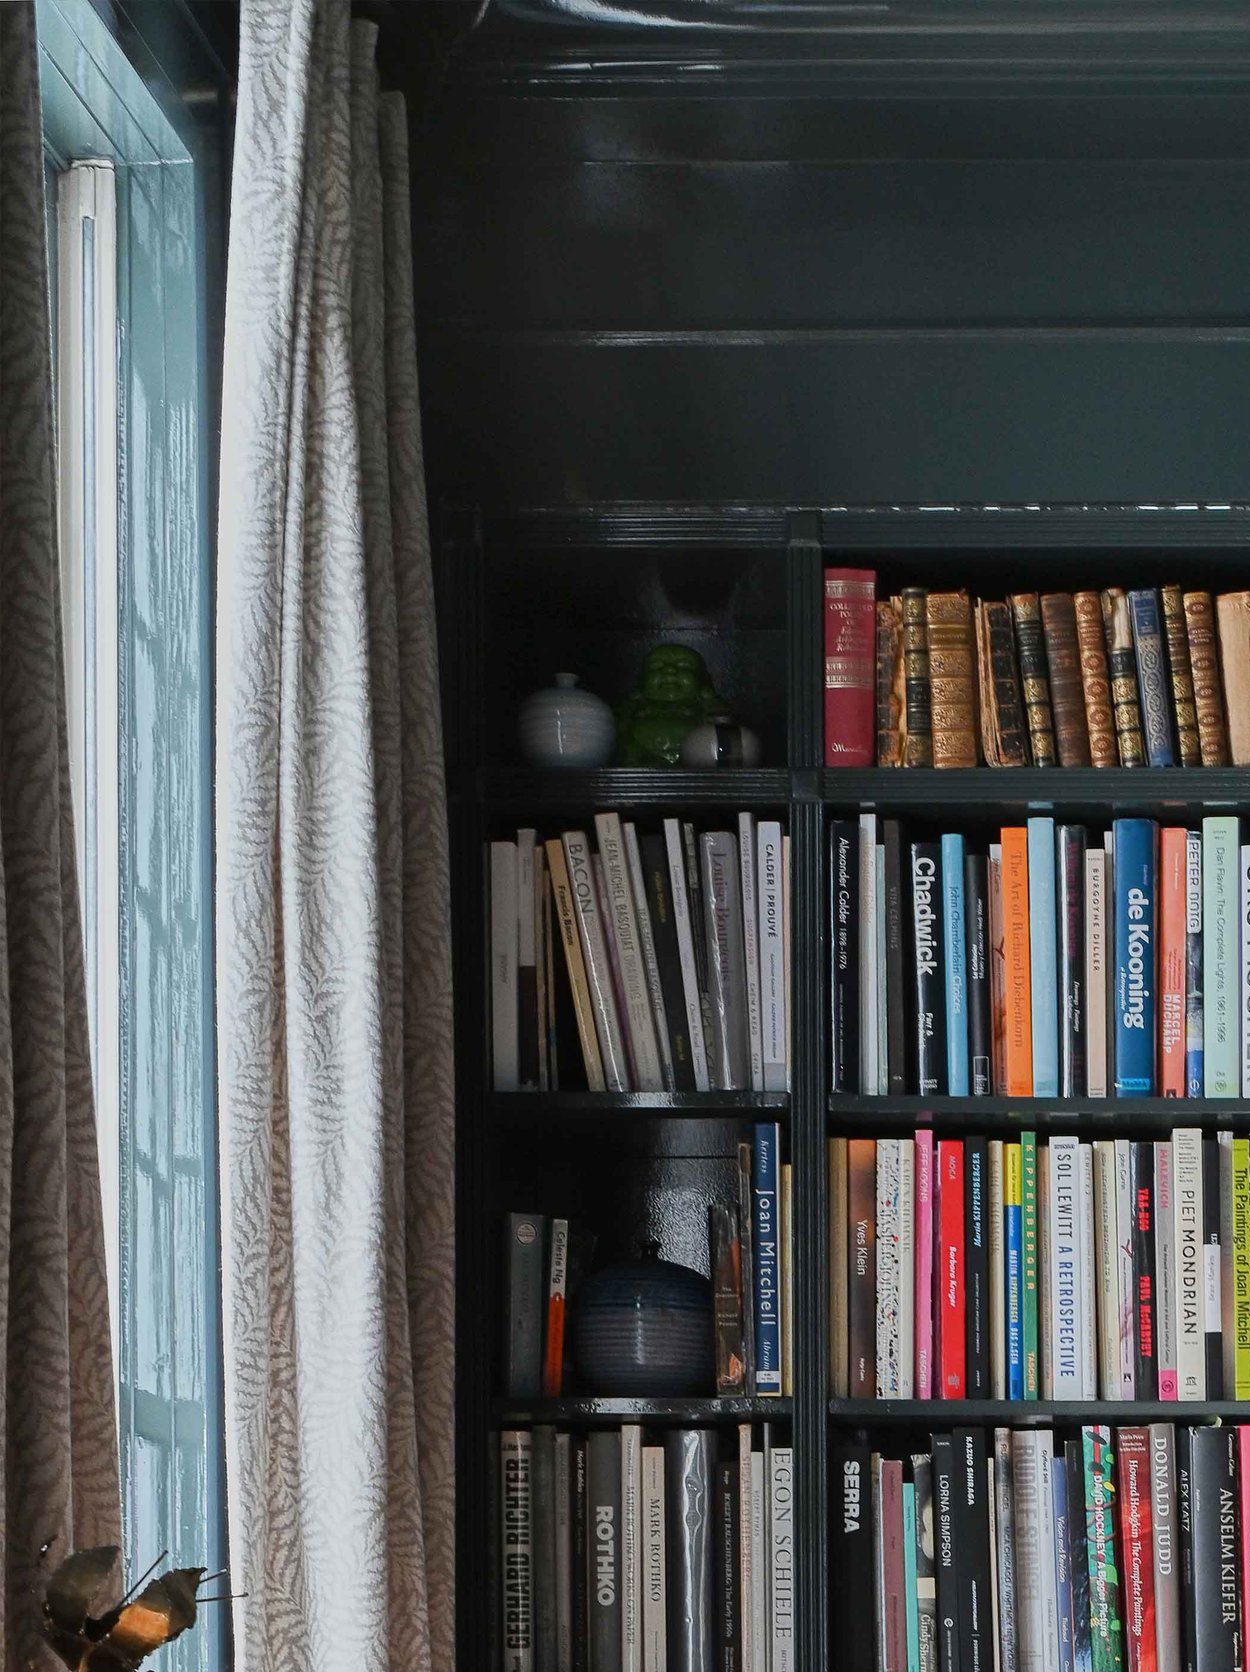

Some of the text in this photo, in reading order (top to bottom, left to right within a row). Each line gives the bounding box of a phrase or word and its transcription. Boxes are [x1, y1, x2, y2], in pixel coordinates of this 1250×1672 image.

[569, 843, 595, 914] BACON
[766, 843, 781, 938] CALDER PROUVÉ
[914, 857, 938, 978] Chadwick
[1123, 888, 1150, 1030] de Kooning
[1162, 992, 1181, 1054] MARCEL DUCHAMP
[552, 1232, 566, 1284] Celeste Ng
[754, 1187, 777, 1326] Joan Mitchell
[856, 1218, 869, 1275] Yves Klein
[1056, 1153, 1076, 1378] SOL LEWITT A RETROSPECTIVE
[1181, 1190, 1198, 1335] PIET MONDRIAN
[649, 1497, 661, 1602] MARK ROTHKO
[773, 1450, 792, 1639] EGON SCHIELE
[843, 1459, 861, 1534] SERRA
[939, 1474, 952, 1567] LORNA SIMPSON
[1153, 1435, 1172, 1576] DONALD JUDD
[506, 1458, 531, 1649] GERHARD RICHTER
[595, 1504, 615, 1606] ROTHKO
[1219, 1487, 1237, 1624] ANSELM KIEFER
